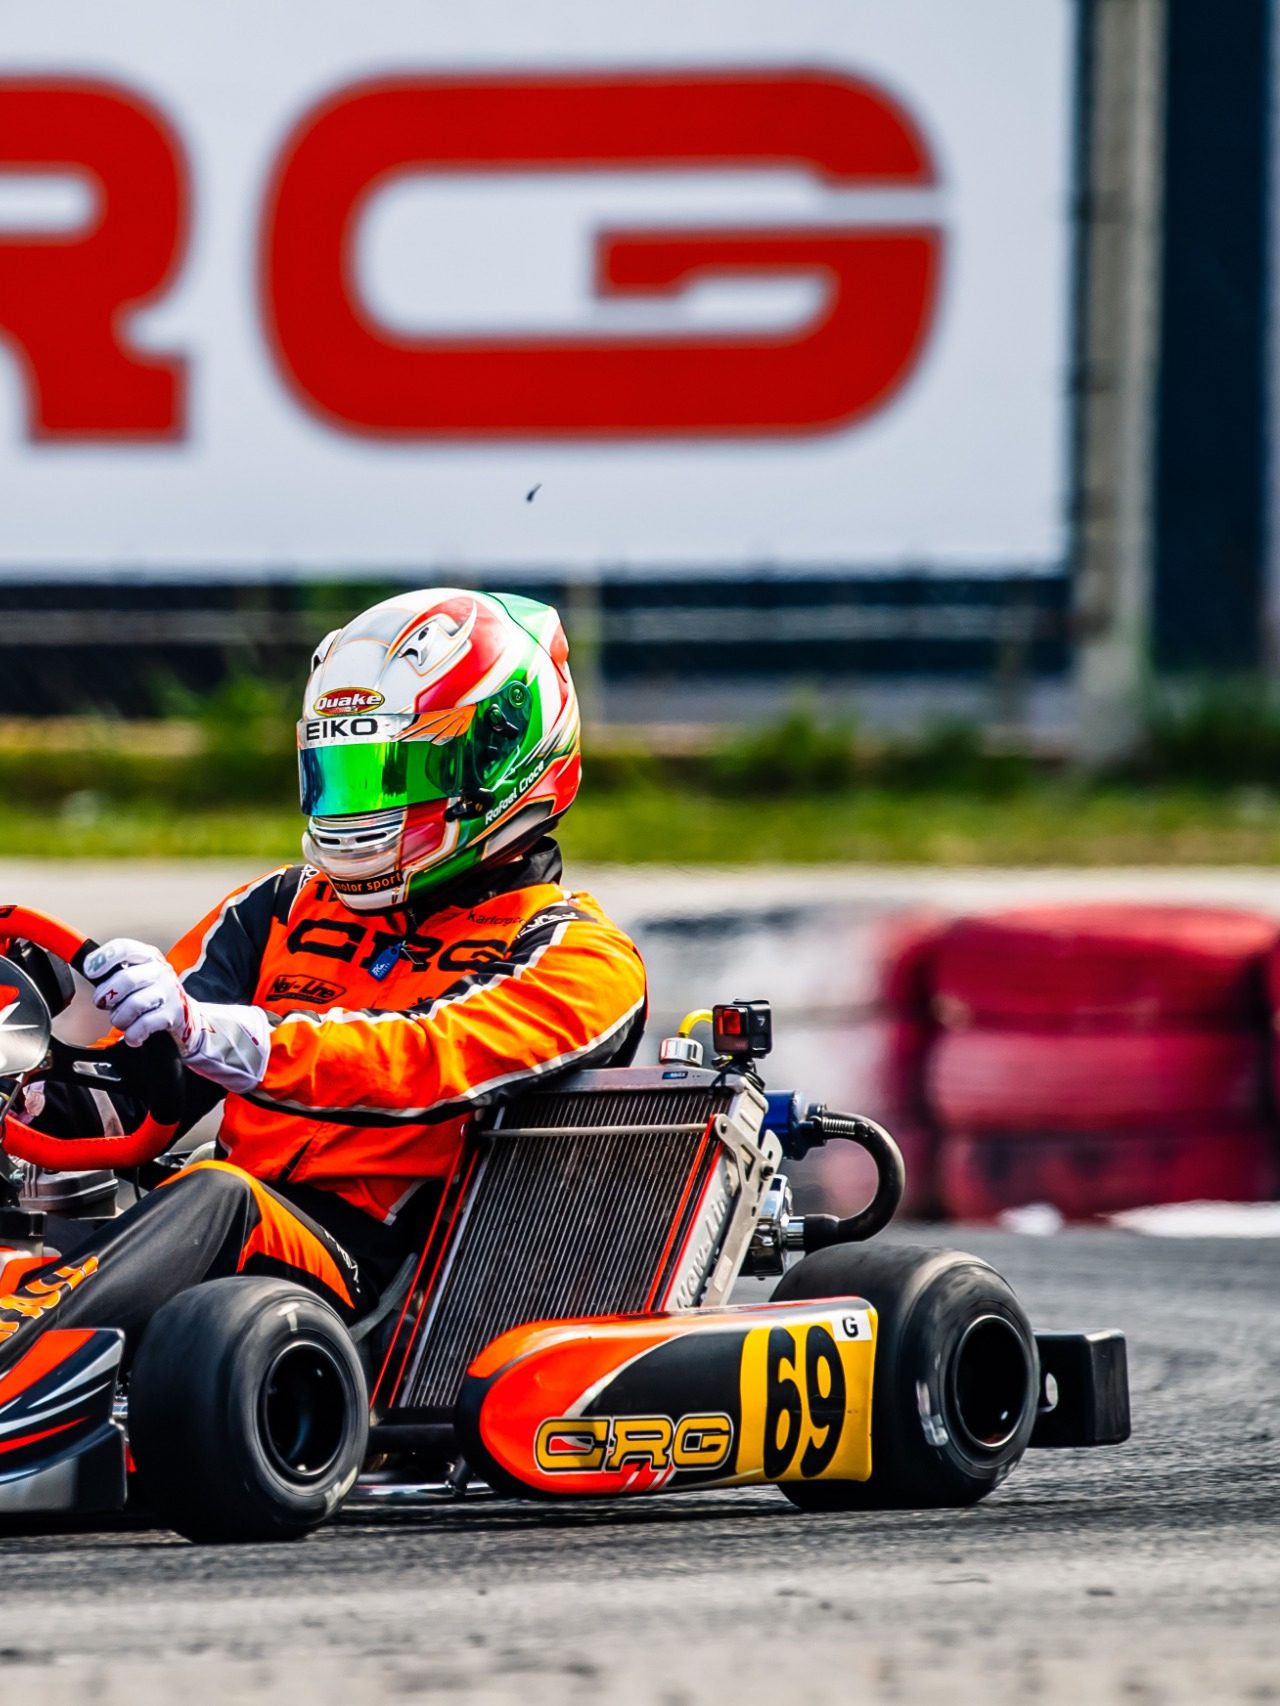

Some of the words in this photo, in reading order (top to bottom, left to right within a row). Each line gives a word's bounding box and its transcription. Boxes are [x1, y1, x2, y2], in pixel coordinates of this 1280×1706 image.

[317, 693, 382, 710] Quake
[366, 872, 401, 891] sport
[286, 918, 508, 973] CRG
[843, 1316, 859, 1338] G
[763, 1325, 847, 1479] 69
[534, 1413, 733, 1475] CRG
